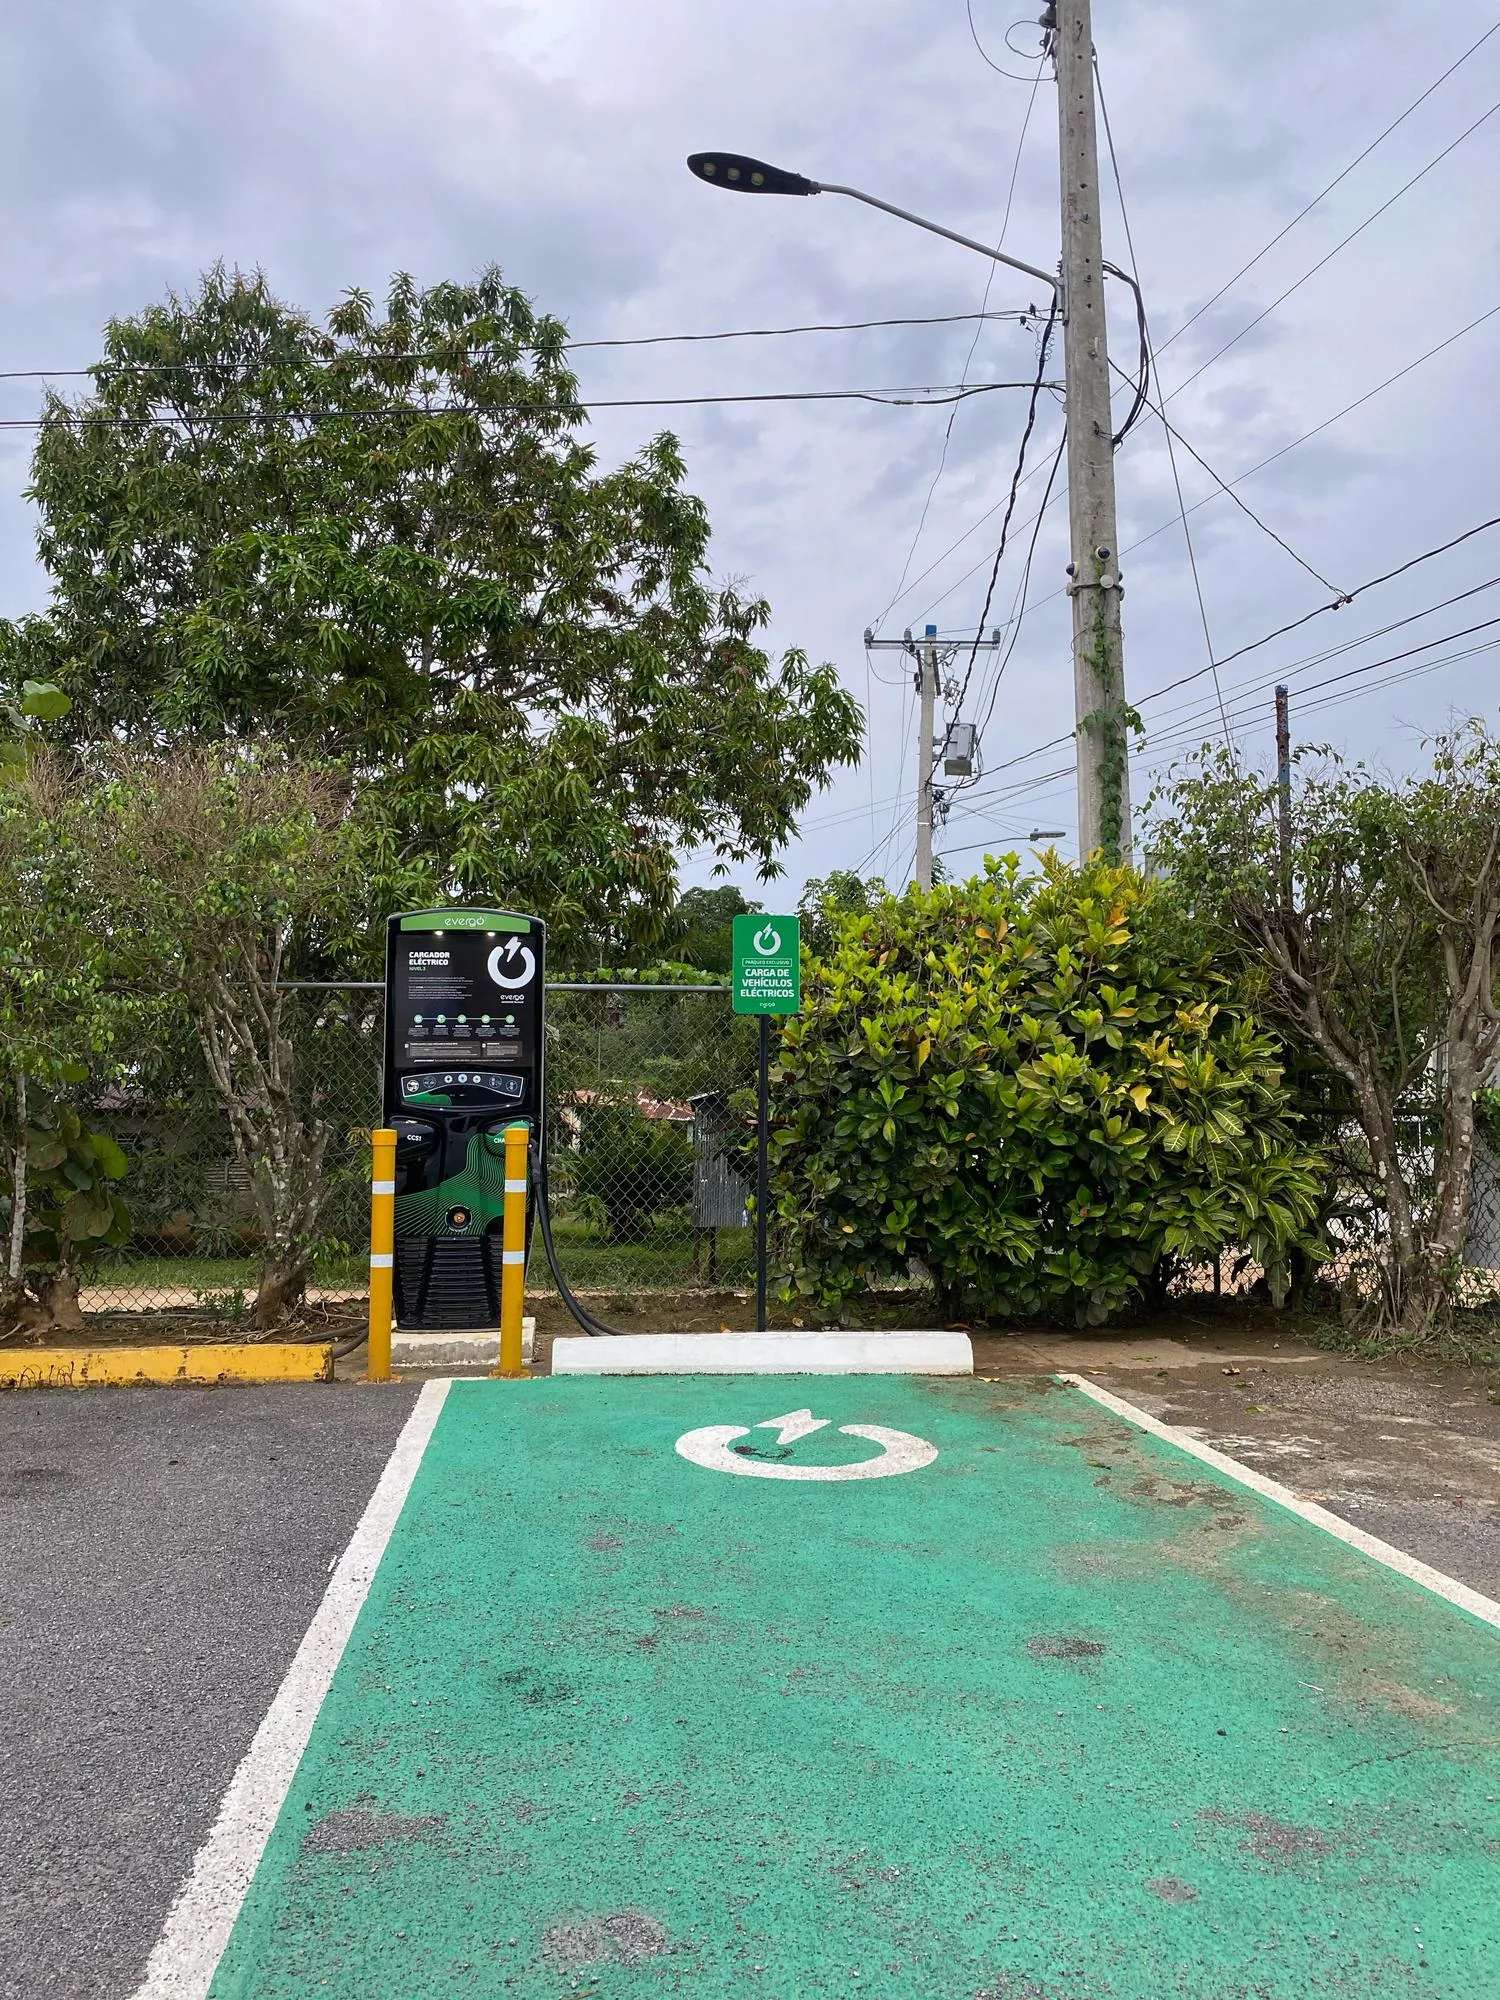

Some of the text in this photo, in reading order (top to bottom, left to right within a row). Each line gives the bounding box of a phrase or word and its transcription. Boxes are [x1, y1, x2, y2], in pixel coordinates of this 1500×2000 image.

[408, 951, 450, 959] CARGADOR
[408, 958, 449, 966] ELÉCTRICO
[742, 977, 792, 987] VEHÍCULOS
[740, 987, 794, 997] ELÉCTRICOS
